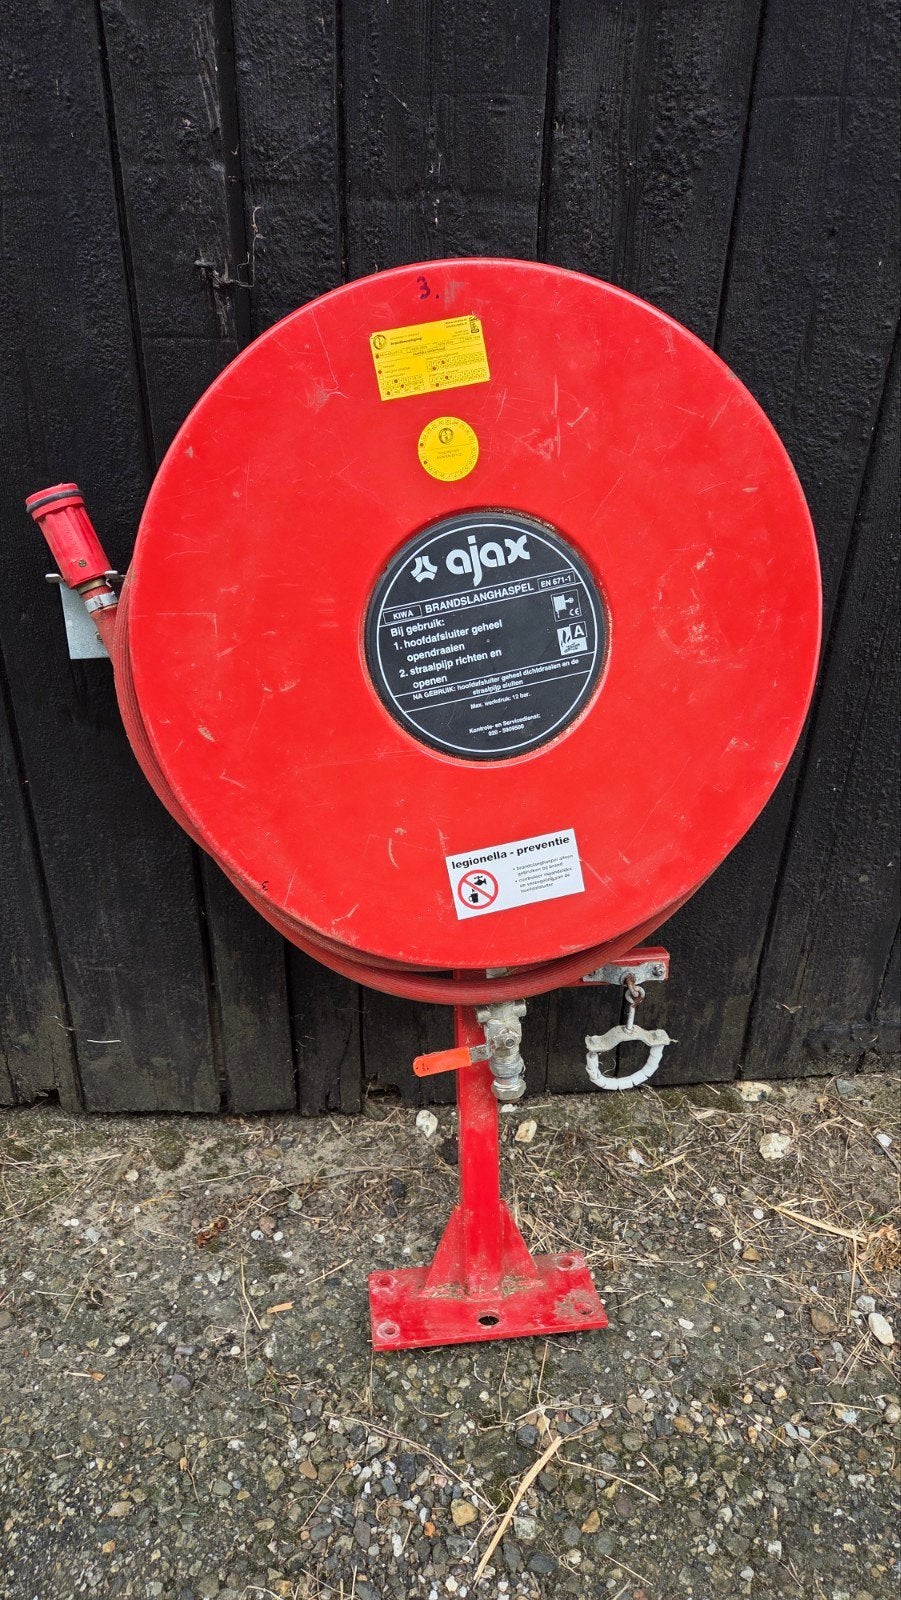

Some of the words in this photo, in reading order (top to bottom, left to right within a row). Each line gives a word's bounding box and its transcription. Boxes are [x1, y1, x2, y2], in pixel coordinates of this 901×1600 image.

[446, 534, 531, 587] ajax
[540, 578, 551, 588] EN
[552, 574, 572, 586] 671-1
[425, 582, 534, 614] BRANDSLANGHASPEL
[393, 609, 414, 620] KIWA
[390, 627, 404, 638] Bij
[406, 618, 445, 636] gebruik:
[393, 641, 402, 651] 1.
[404, 628, 470, 649] hoofdafsluiter
[471, 619, 503, 636] geheel
[574, 624, 585, 638] A
[407, 643, 465, 663] opendraaien
[399, 669, 408, 678] 2.
[410, 660, 453, 676] straalpijp
[455, 652, 488, 666] richten
[490, 649, 502, 658] en
[412, 675, 448, 689] openen
[412, 693, 423, 701] NA
[423, 686, 456, 698] GEBRUIK:
[457, 676, 500, 691] hoofdafsluiter
[501, 671, 522, 683] geheel
[522, 663, 561, 676] dichtdraaien
[472, 684, 501, 696] straalpijp
[502, 680, 524, 689] sluiten
[451, 850, 508, 871] legionella
[516, 836, 570, 857] preventie
